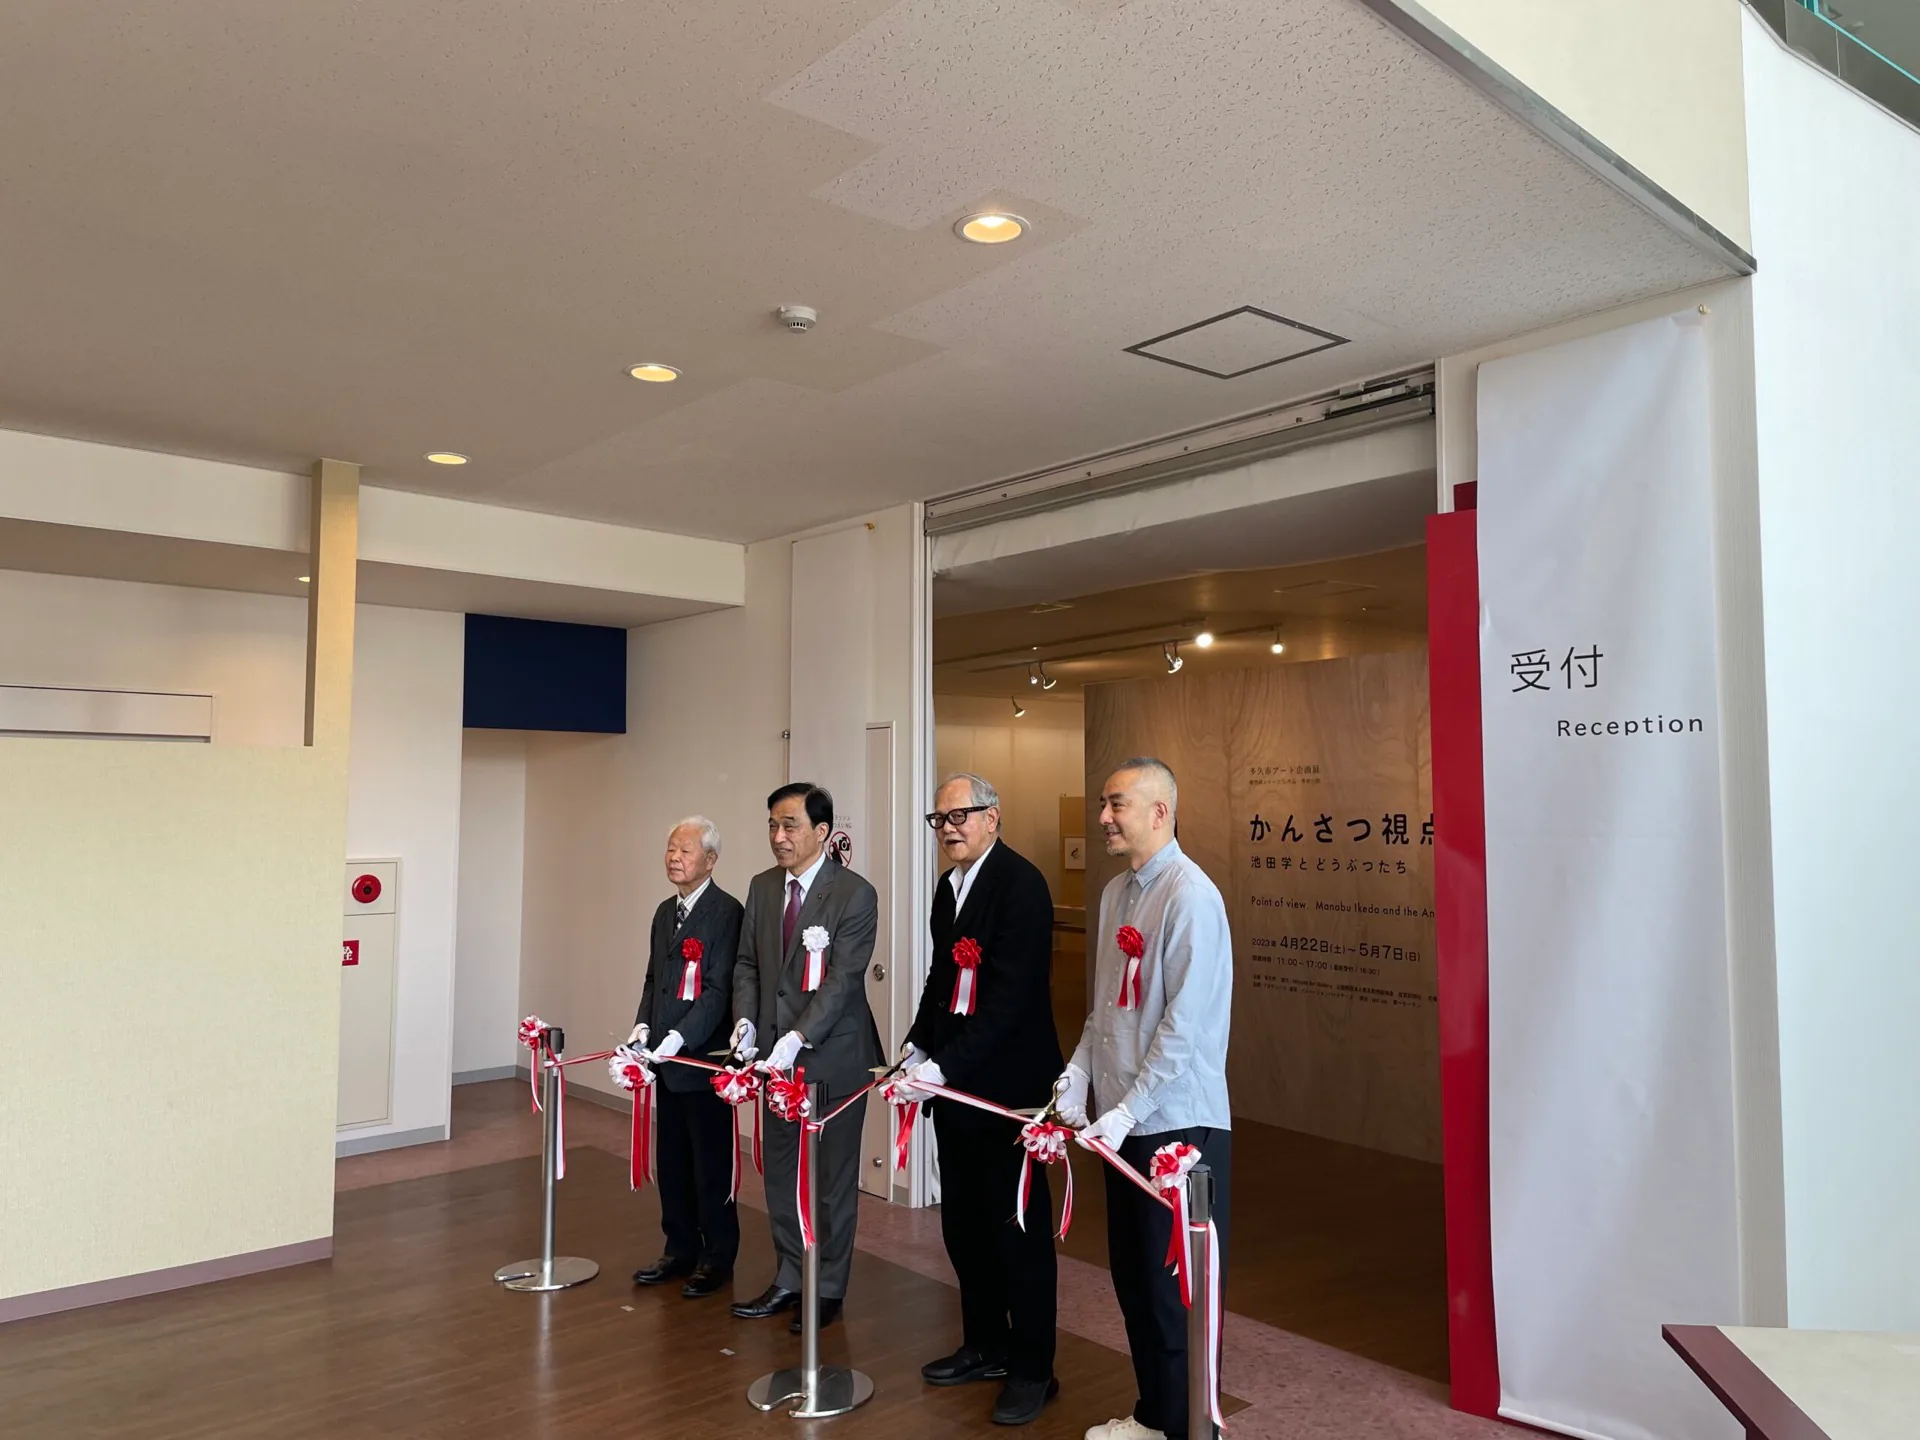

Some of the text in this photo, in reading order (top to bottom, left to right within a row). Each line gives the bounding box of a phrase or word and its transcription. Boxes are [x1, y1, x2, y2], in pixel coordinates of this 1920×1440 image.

[1510, 644, 1604, 693] 受付
[1557, 714, 1703, 737] Reception
[1251, 855, 1407, 874] 池田学とどうぶつたち
[1251, 896, 1272, 907] Point
[1274, 897, 1284, 908] of
[1315, 901, 1351, 913] Manabu
[1354, 903, 1379, 914] Ikeda
[1383, 904, 1400, 916] and
[1403, 905, 1418, 917] the
